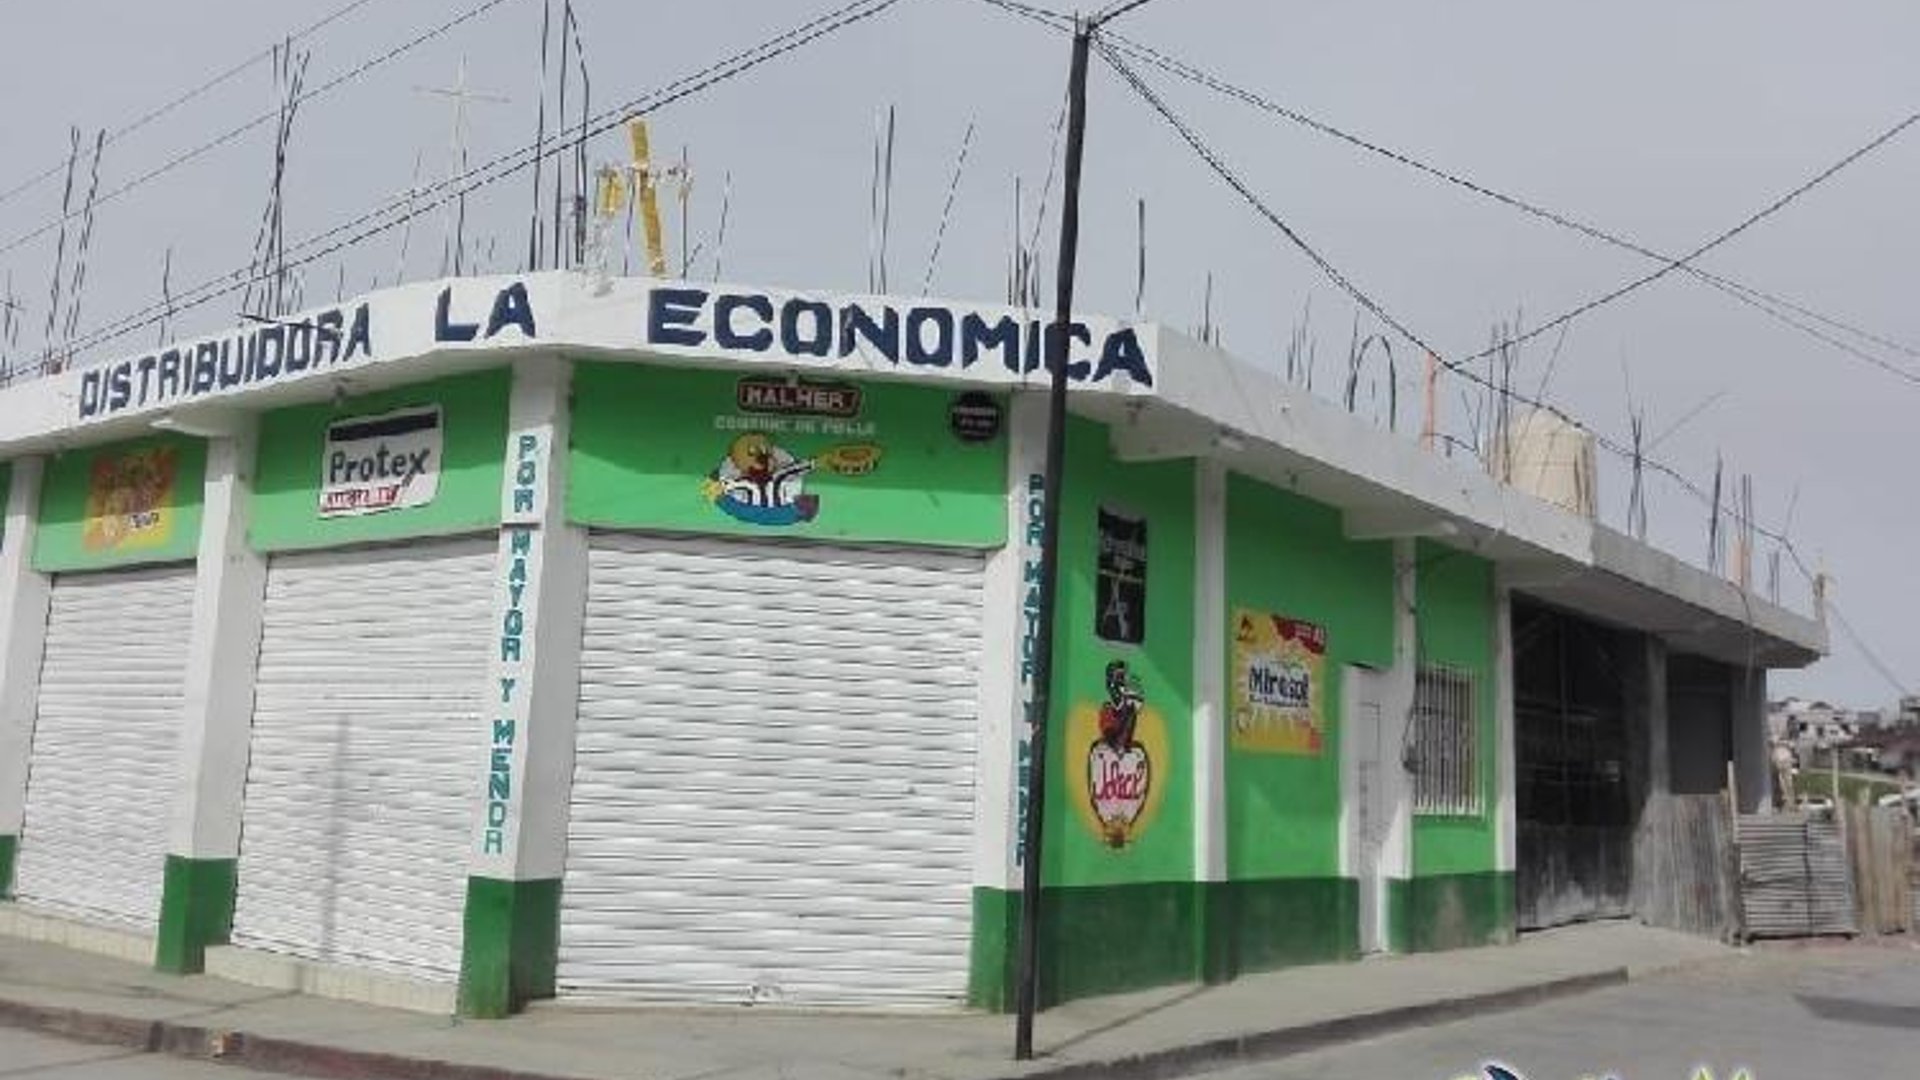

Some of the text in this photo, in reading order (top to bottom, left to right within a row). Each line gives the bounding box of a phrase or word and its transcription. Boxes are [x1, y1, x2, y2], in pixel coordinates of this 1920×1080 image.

[79, 281, 1154, 419] DISTRIBUIDORA LA ECONOMICA
[746, 385, 845, 408] MALHER
[329, 442, 431, 483] Protex
[483, 434, 538, 854] POR MAYOR Y MENOR
